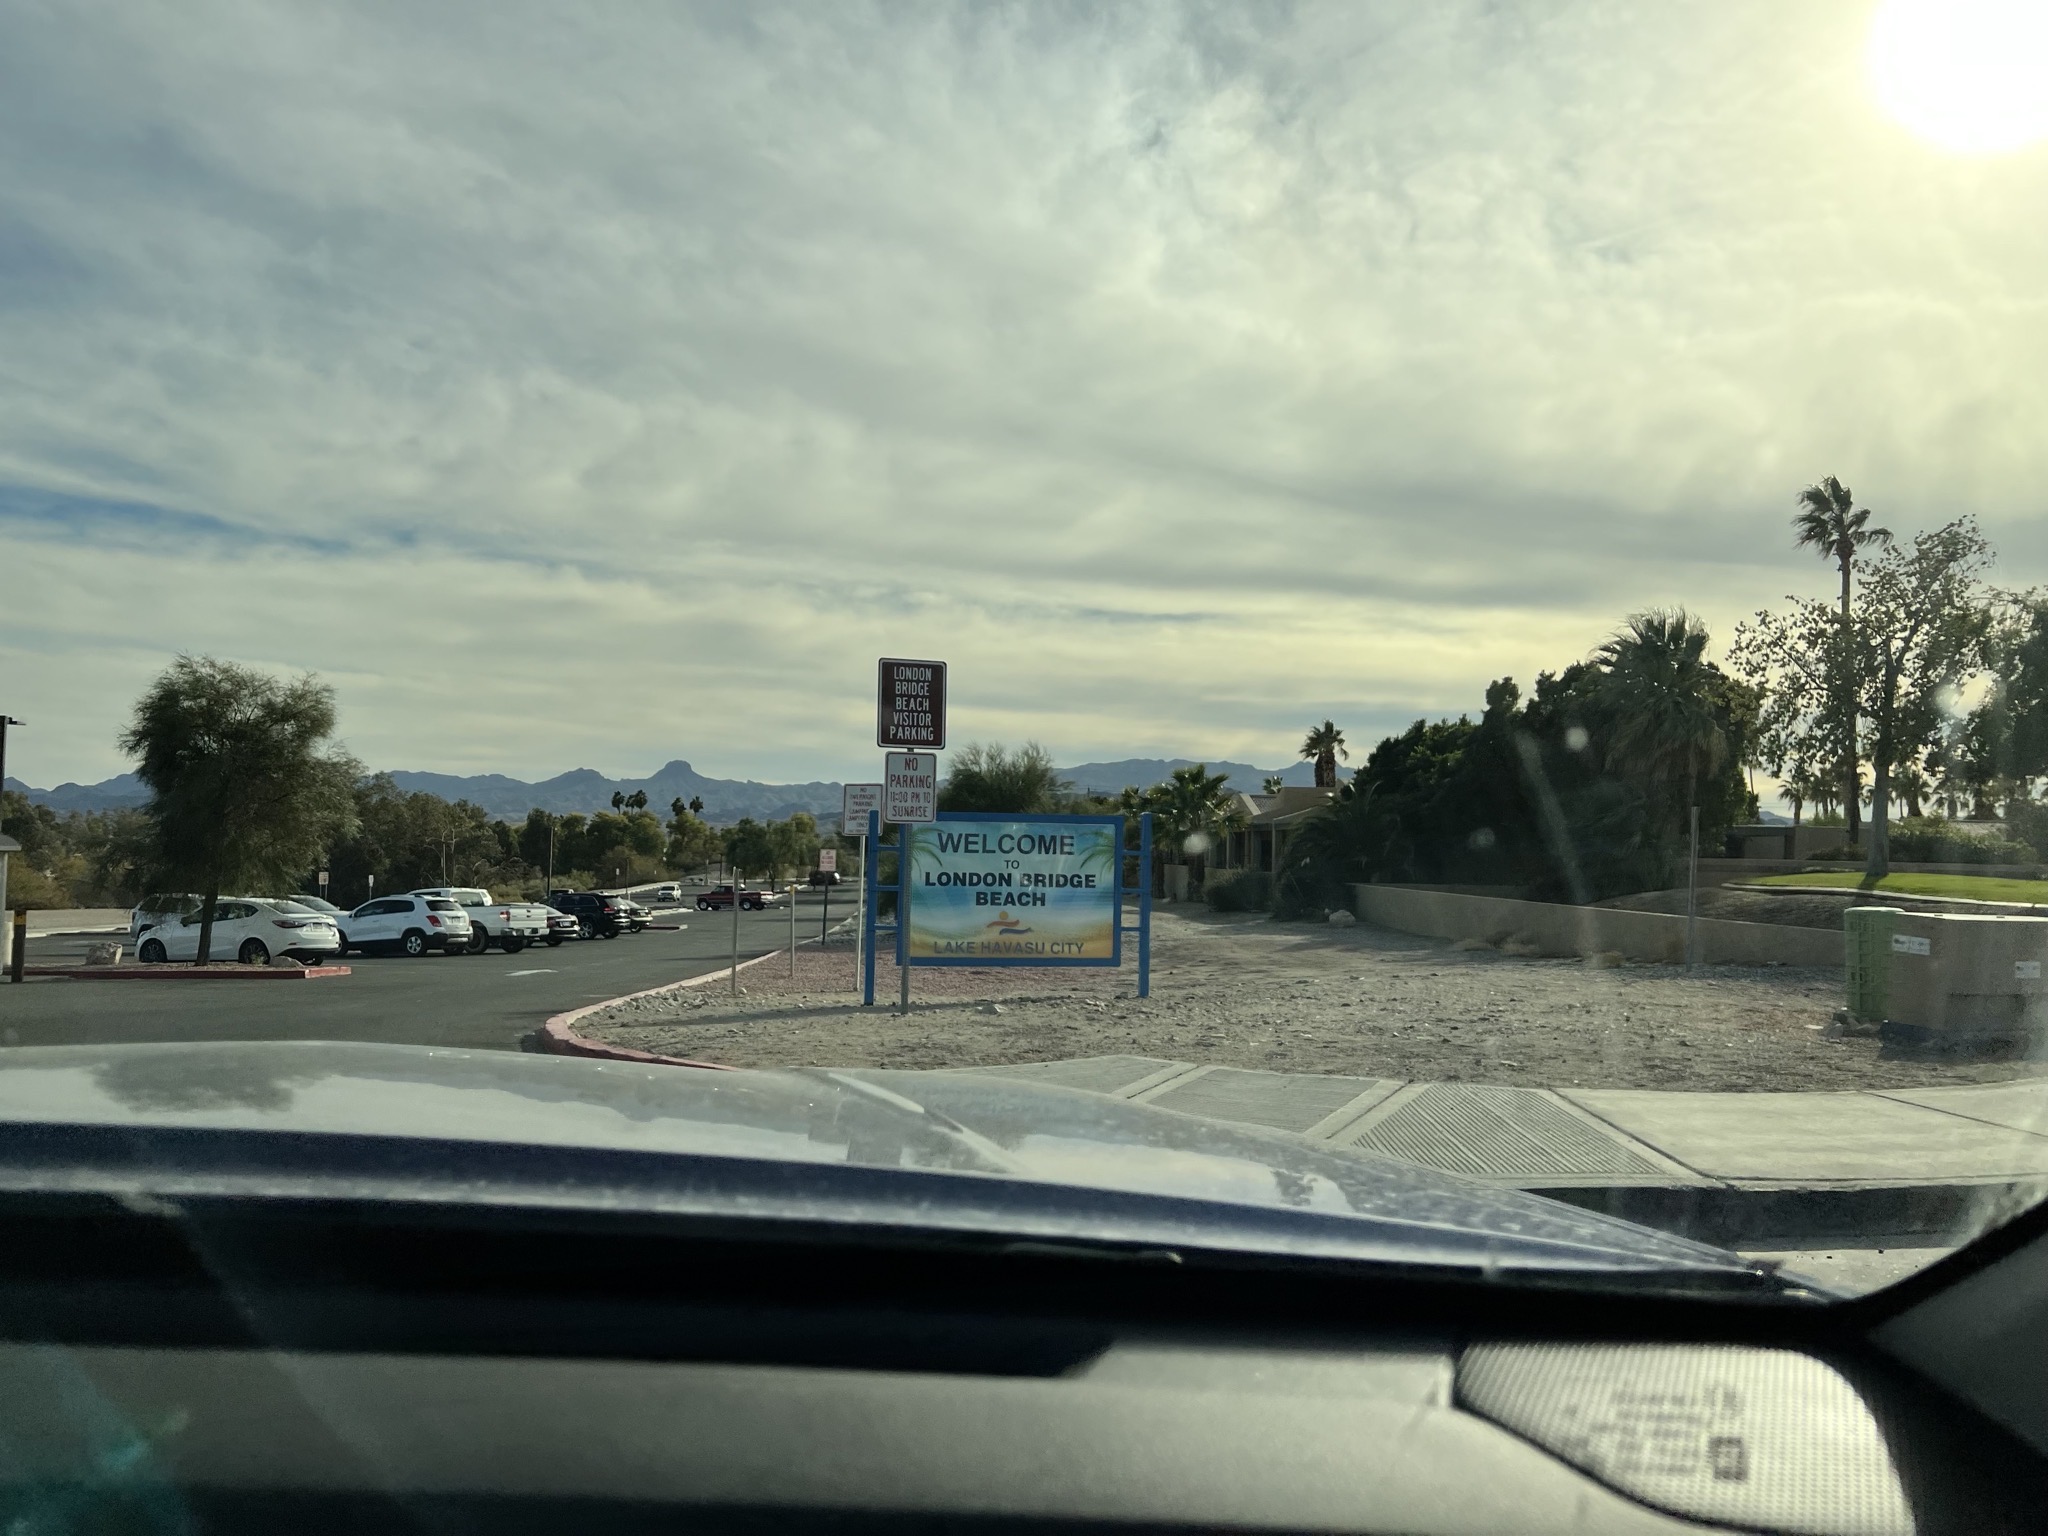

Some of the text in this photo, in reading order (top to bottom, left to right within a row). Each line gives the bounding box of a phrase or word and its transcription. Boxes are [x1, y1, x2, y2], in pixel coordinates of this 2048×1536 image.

[893, 666, 932, 681] LONDON
[895, 682, 930, 696] BRIDGE
[895, 697, 929, 711] BEACH
[893, 712, 932, 726] VISITOR
[889, 726, 934, 741] PARKING
[904, 757, 918, 772] NO
[890, 774, 932, 789] PARKING
[911, 791, 920, 803] PM
[892, 805, 928, 818] SUNRISE
[937, 832, 1075, 856] WELCOME
[1004, 859, 1020, 870] TO
[924, 871, 1097, 889] LONDON BRIDGE
[975, 891, 1046, 907] BEACH
[933, 941, 1085, 955] LAKE HAVASU CITY
